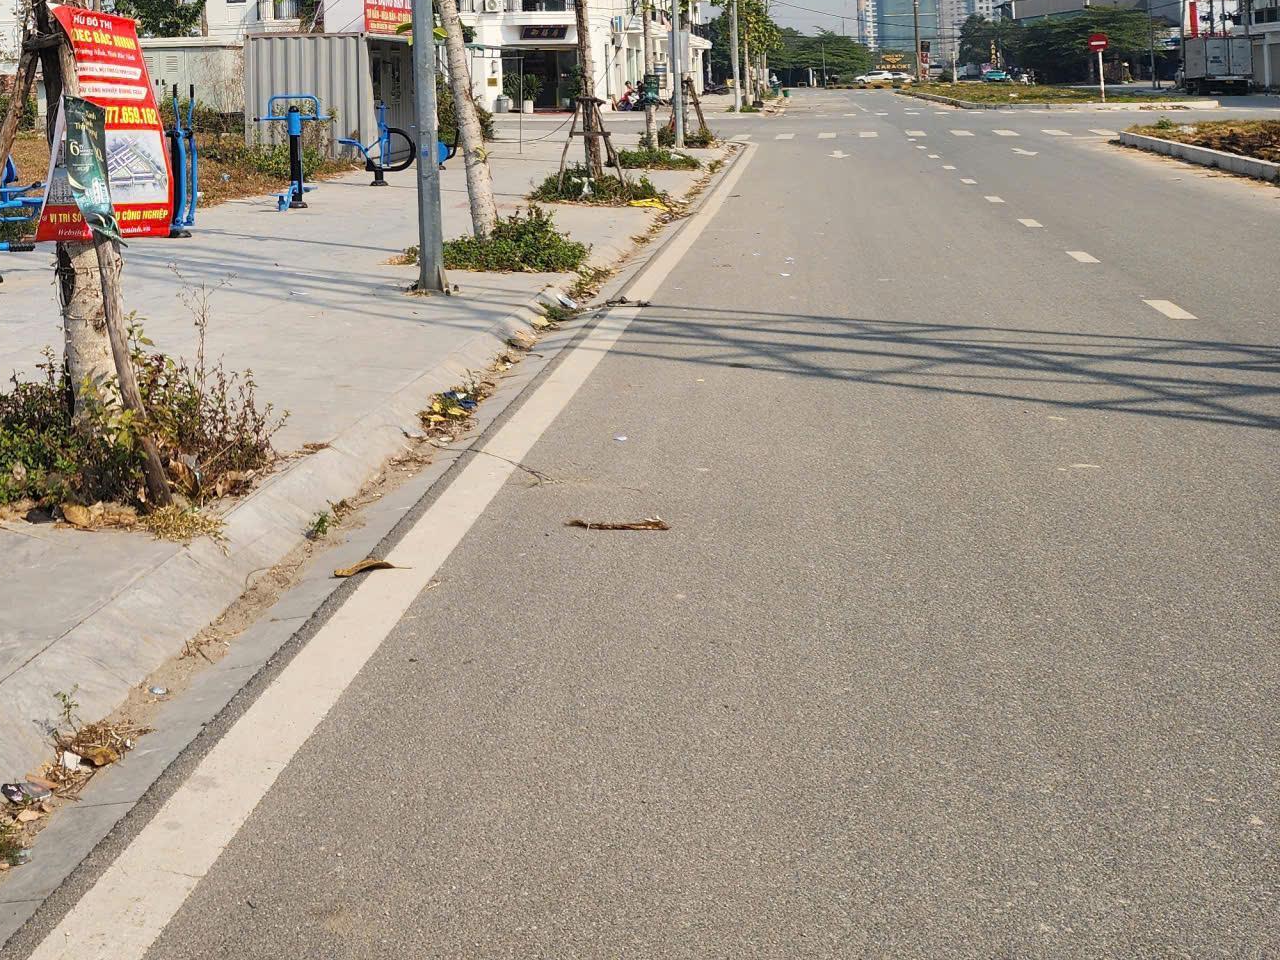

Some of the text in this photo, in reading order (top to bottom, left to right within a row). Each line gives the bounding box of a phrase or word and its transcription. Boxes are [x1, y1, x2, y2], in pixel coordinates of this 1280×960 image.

[73, 15, 85, 25] HU
[86, 15, 98, 27] ĐÔ
[122, 210, 141, 221] CÔNG
[142, 208, 168, 221] NGHIỆP
